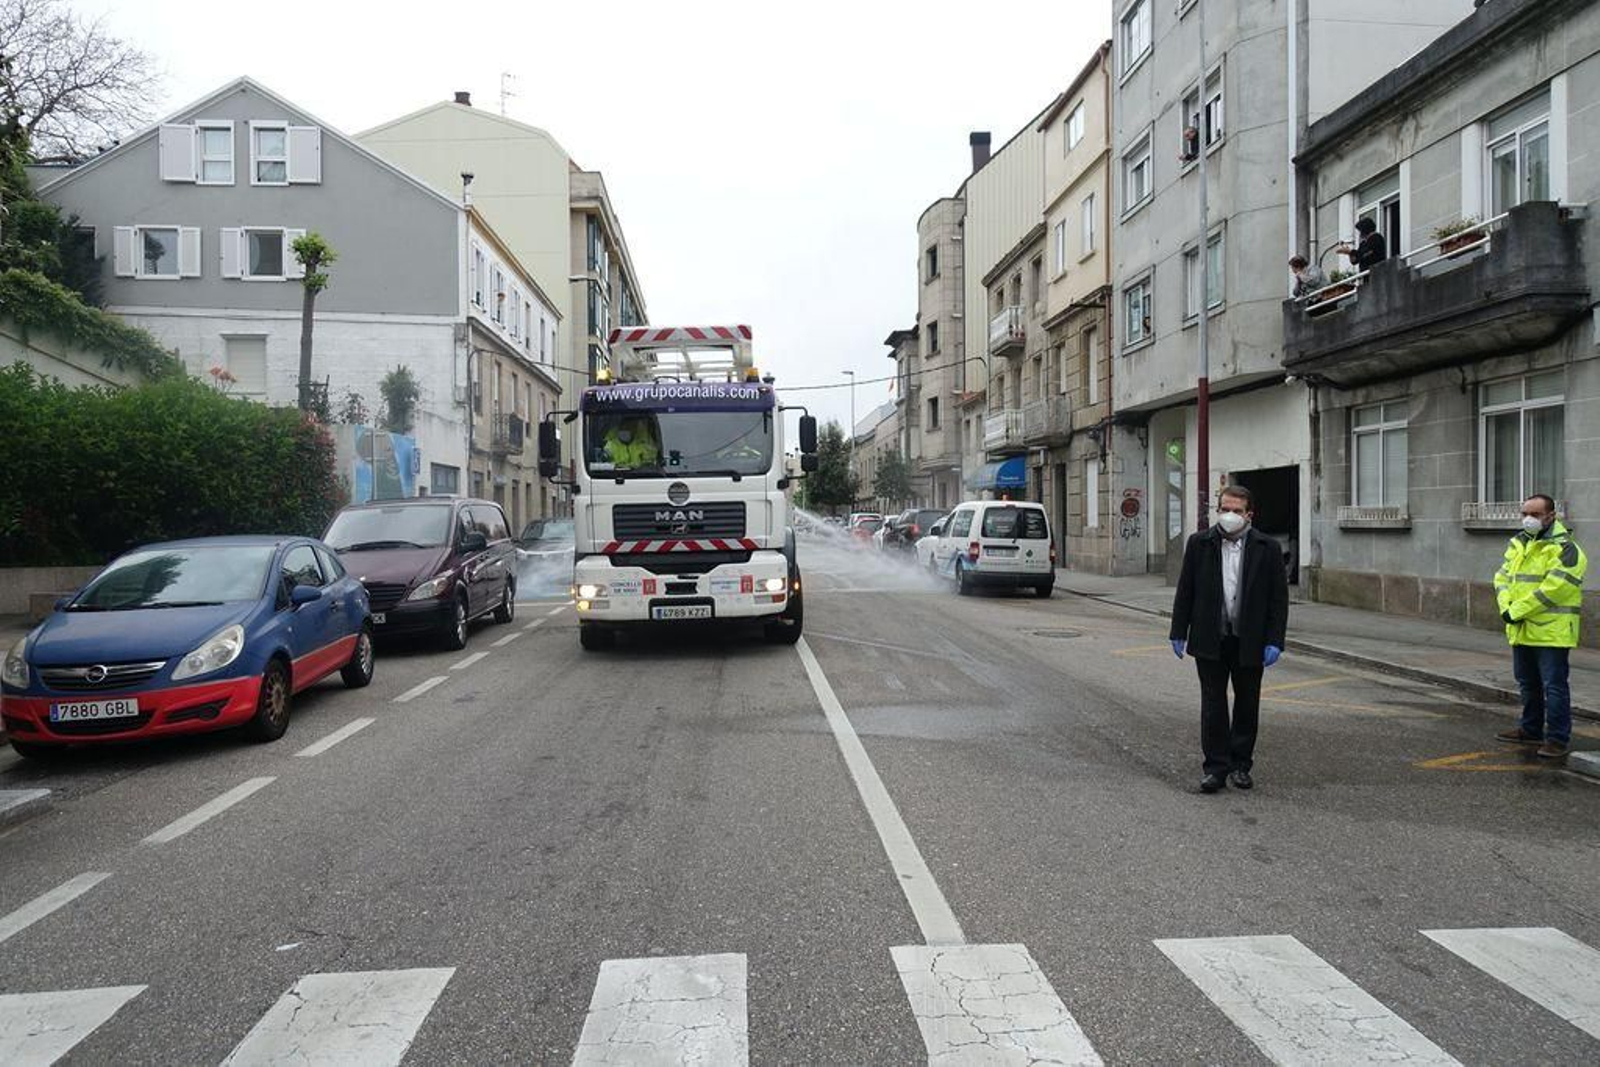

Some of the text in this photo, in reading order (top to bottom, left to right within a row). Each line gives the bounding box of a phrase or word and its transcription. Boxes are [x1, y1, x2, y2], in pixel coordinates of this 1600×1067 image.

[596, 386, 760, 401] www.grupocanalis.com
[655, 511, 704, 521] MAN
[60, 701, 135, 719] 7880 GBL
